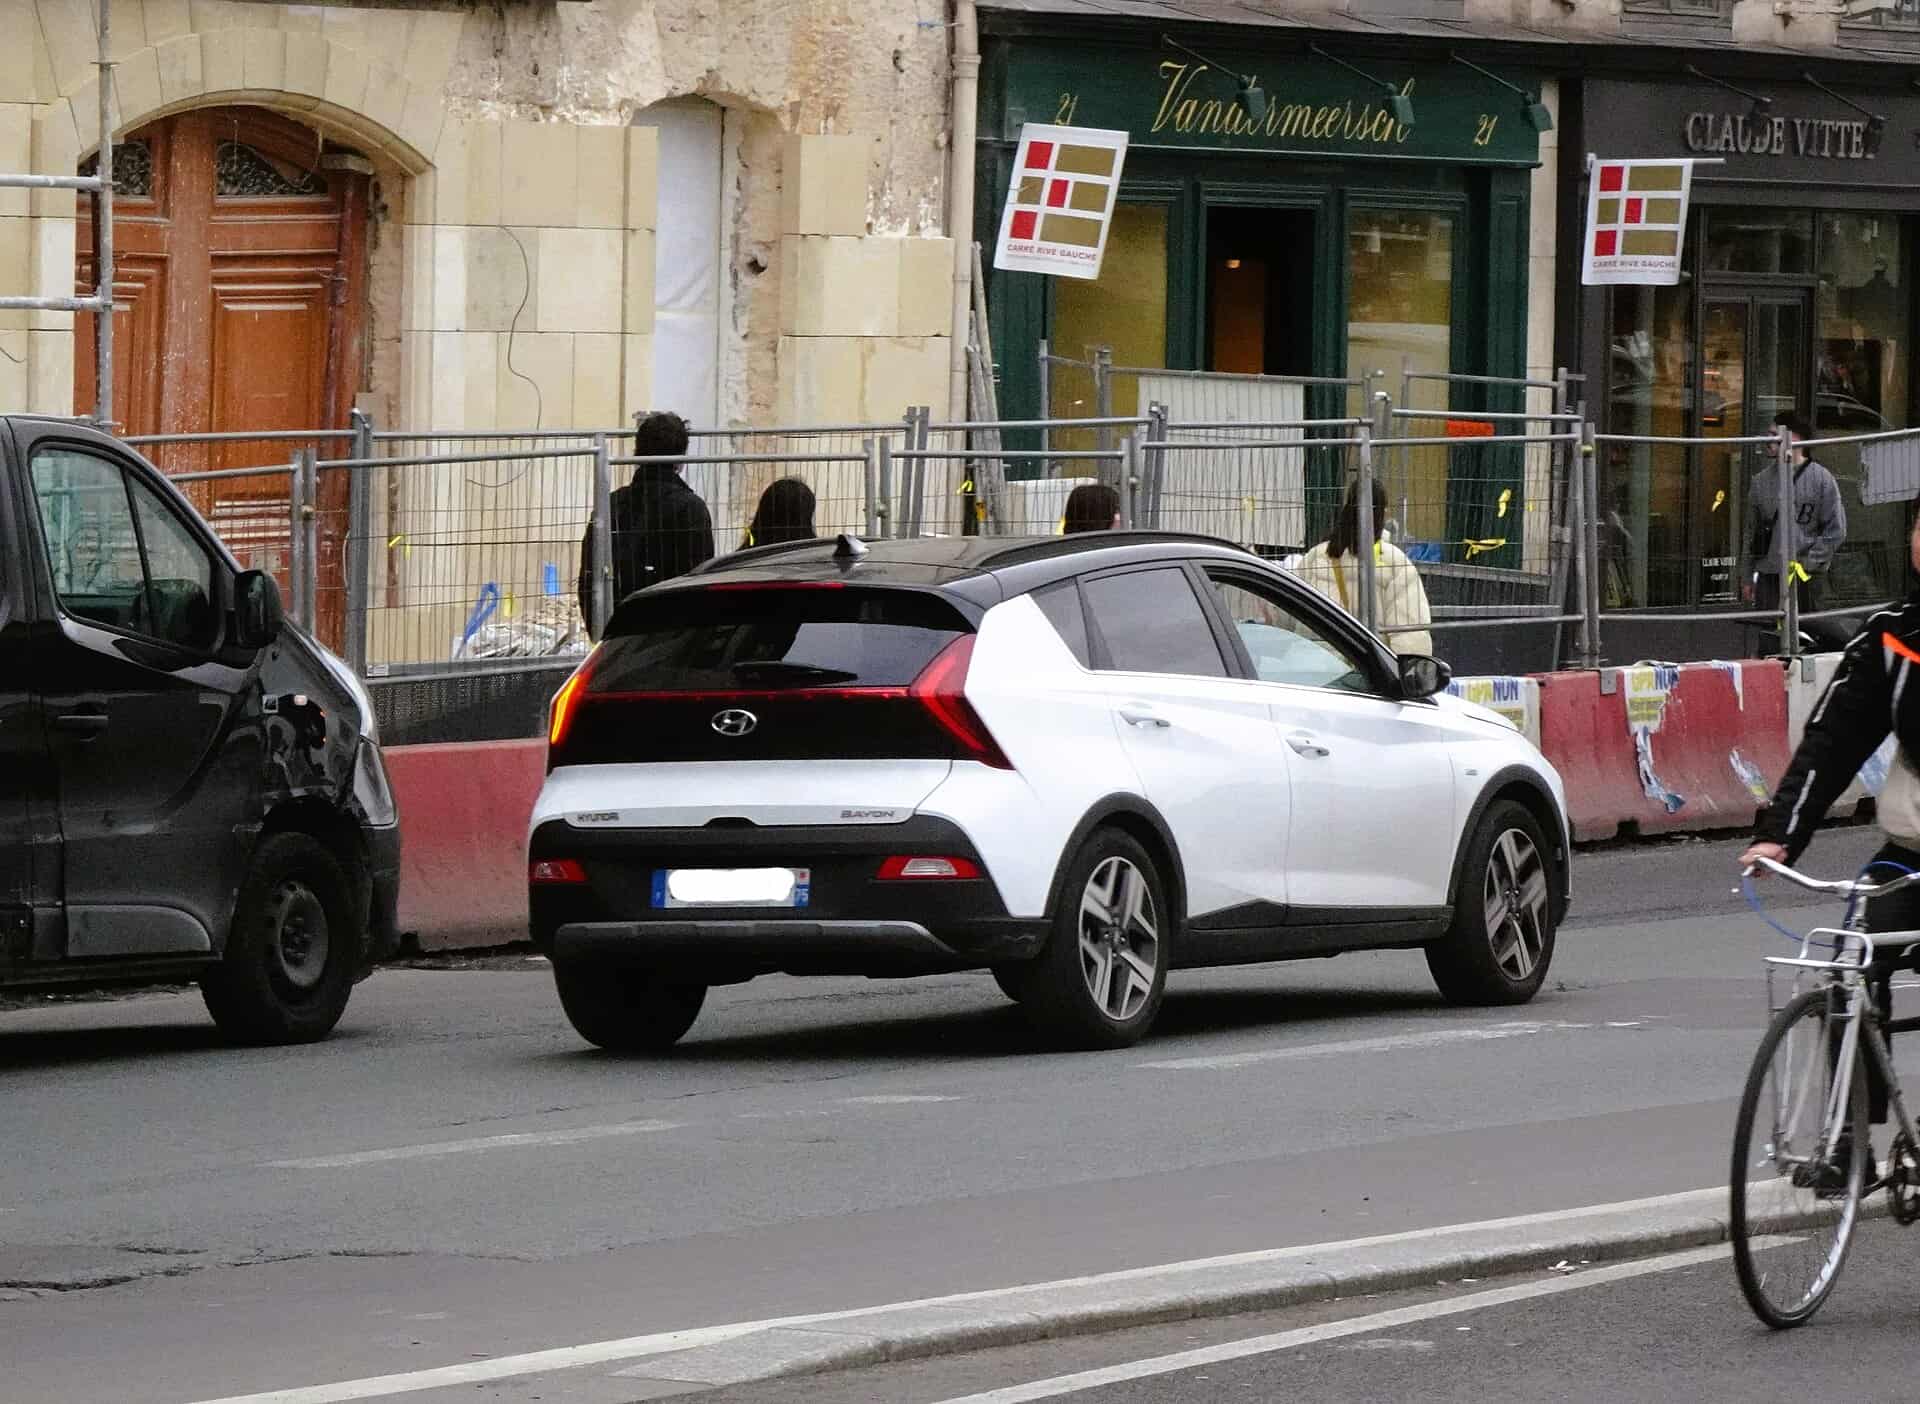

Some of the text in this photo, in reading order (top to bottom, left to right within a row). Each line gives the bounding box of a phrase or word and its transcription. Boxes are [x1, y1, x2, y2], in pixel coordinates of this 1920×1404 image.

[1054, 92, 1079, 125] 21
[1473, 113, 1499, 146] 21
[1686, 111, 1876, 159] CLAUDE VITTE
[1036, 247, 1057, 256] RIVE
[1059, 248, 1097, 261] GAUCHE
[1796, 503, 1814, 525] B
[840, 809, 896, 819] BAYON
